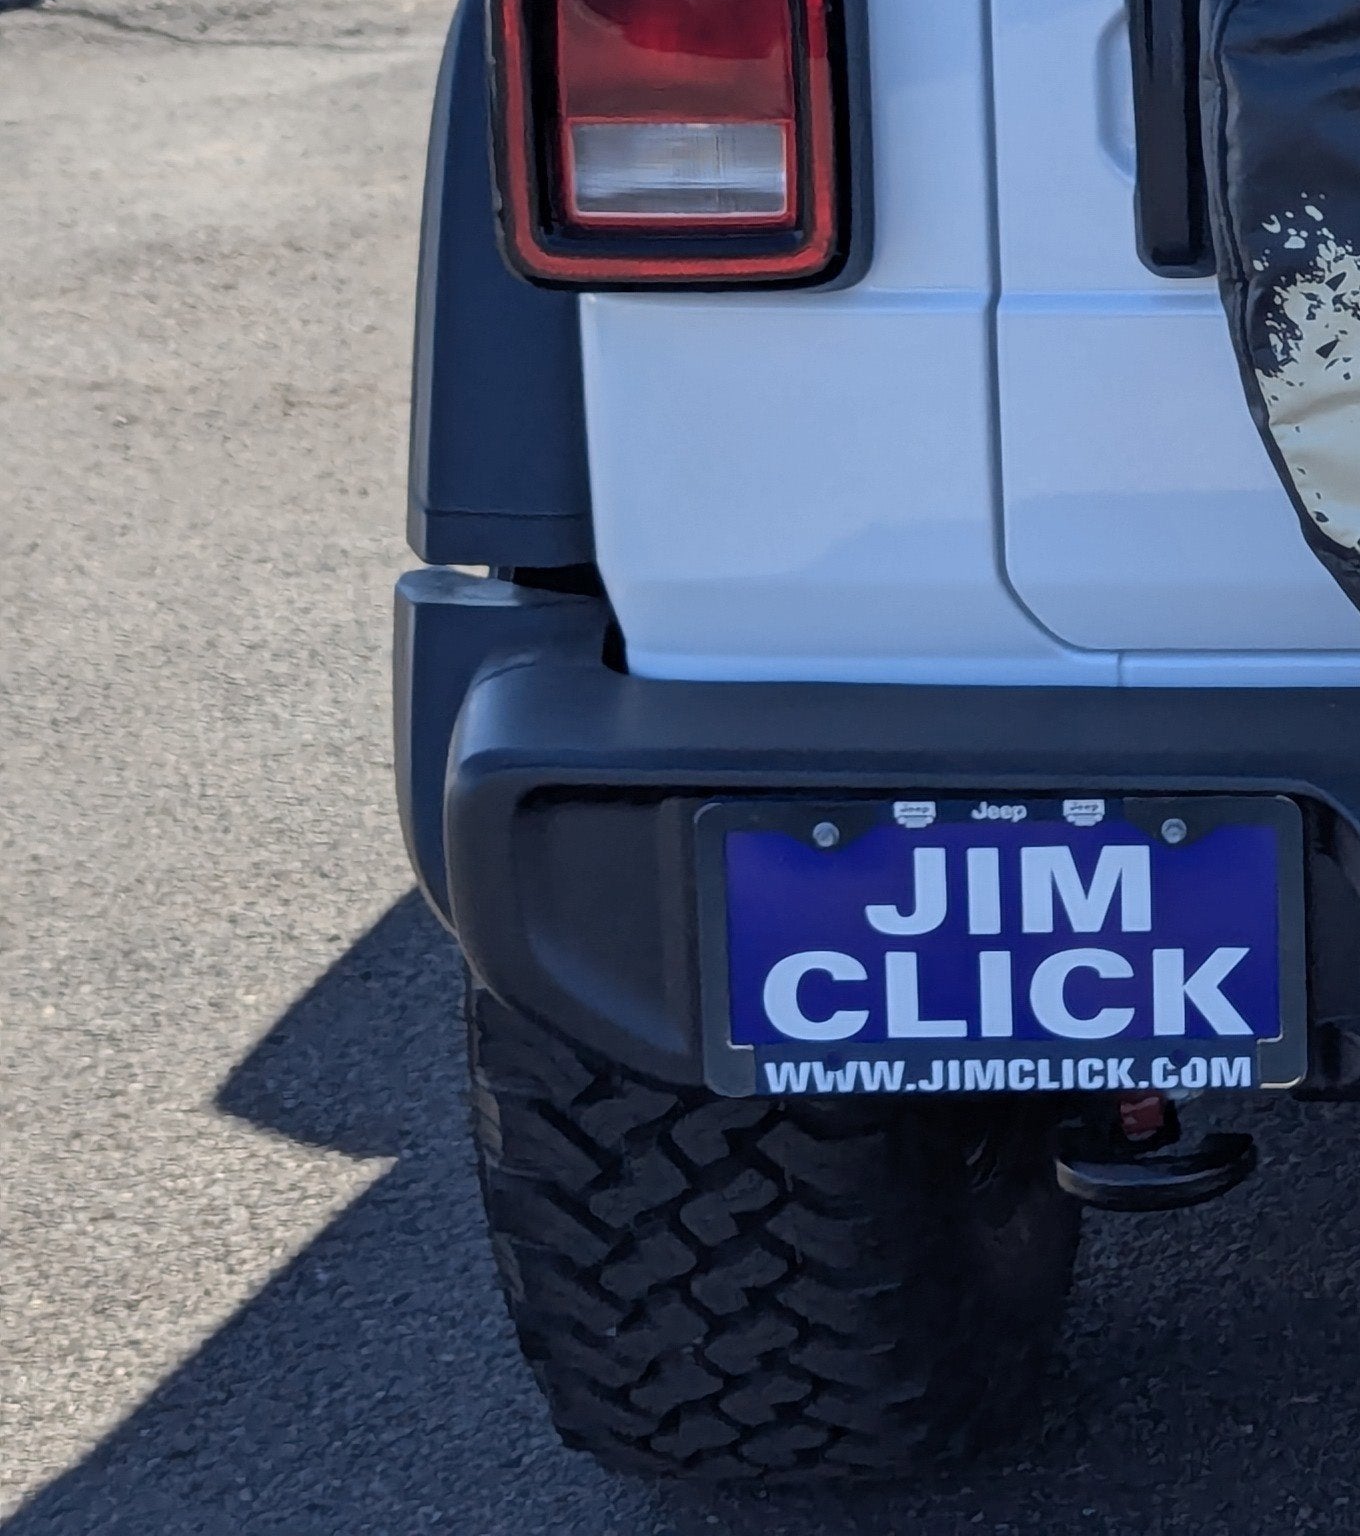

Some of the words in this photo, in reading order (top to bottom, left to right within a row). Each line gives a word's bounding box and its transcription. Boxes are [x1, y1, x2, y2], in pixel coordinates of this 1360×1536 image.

[971, 801, 1027, 823] Jeep
[865, 845, 1152, 935] JIM
[762, 947, 1254, 1040] CLICK
[765, 1056, 1252, 1094] WWW.JIMCLICK.COM
